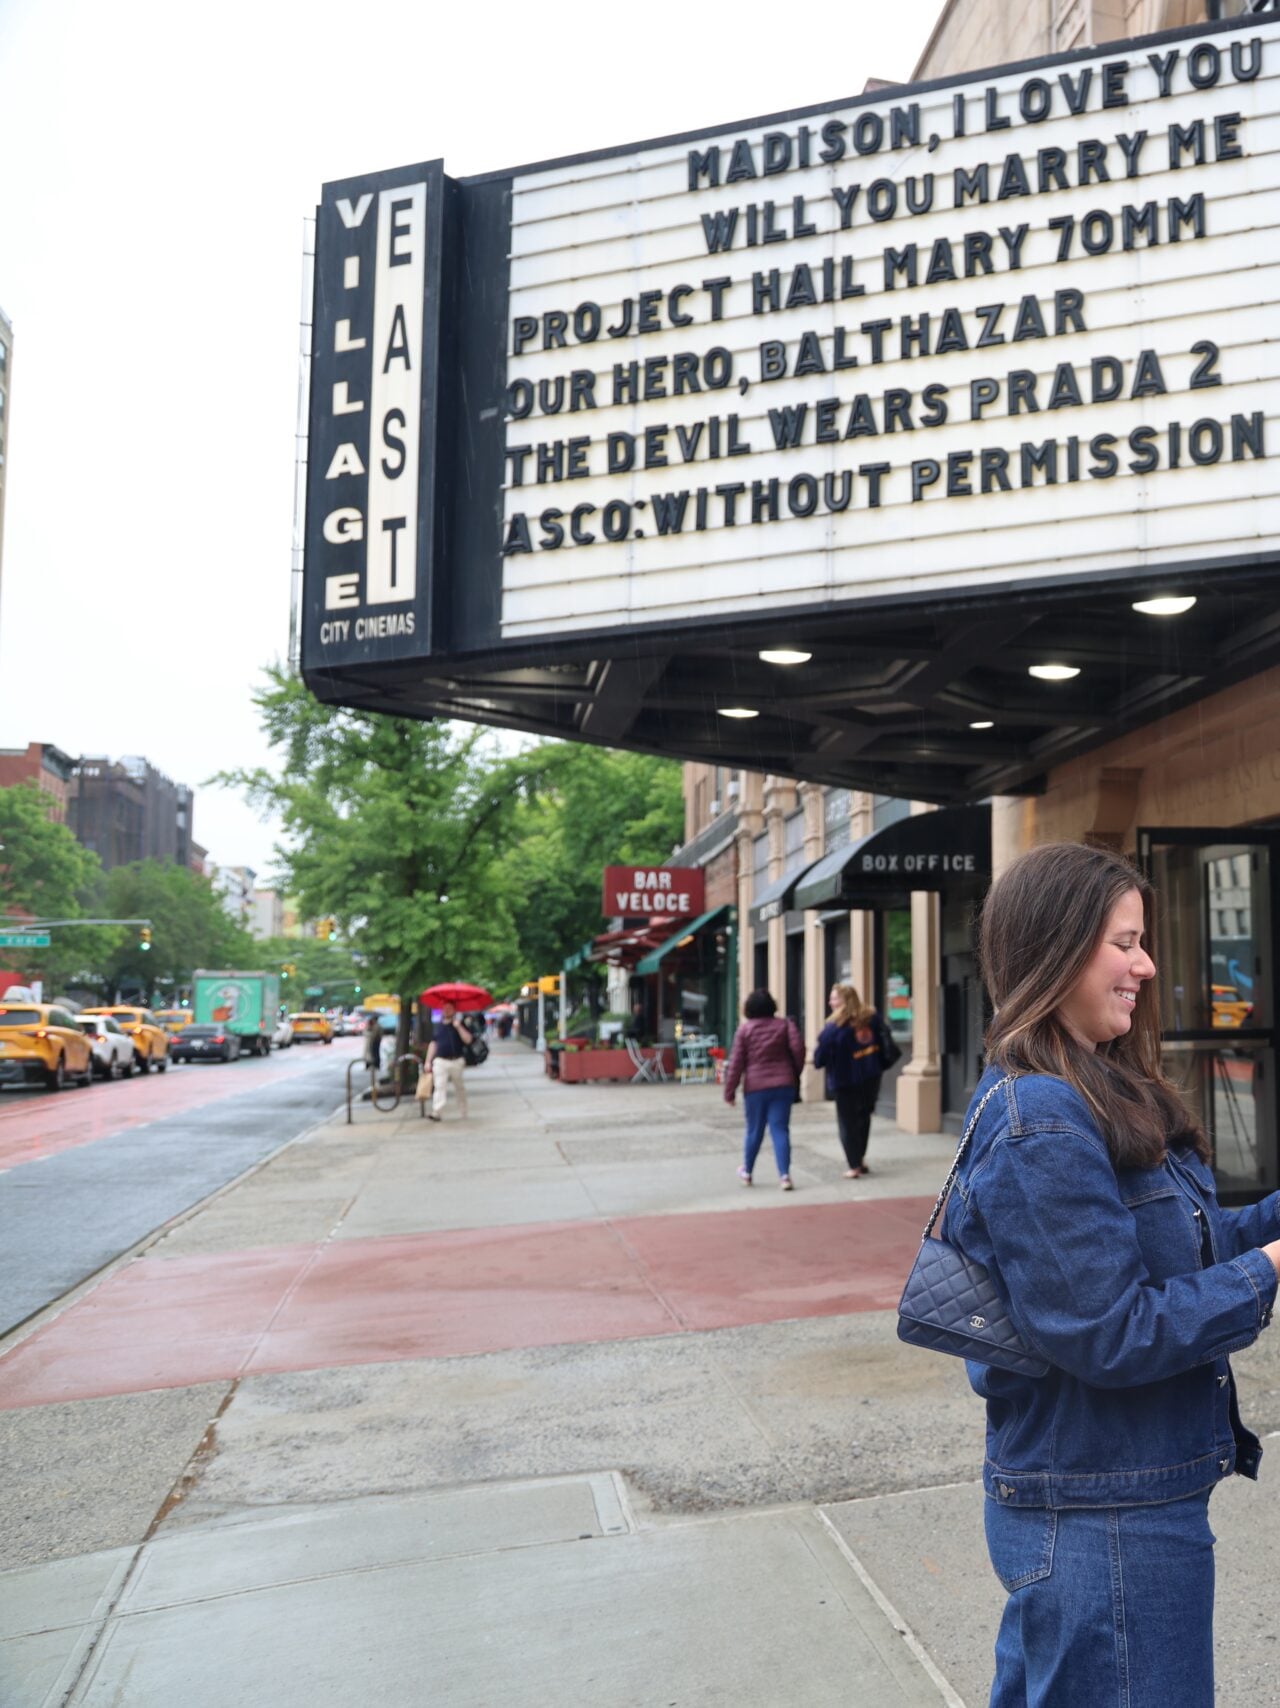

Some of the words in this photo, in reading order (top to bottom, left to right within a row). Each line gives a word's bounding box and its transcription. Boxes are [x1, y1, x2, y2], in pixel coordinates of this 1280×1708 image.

[687, 103, 943, 193] MADISON,
[952, 93, 967, 139] I
[985, 60, 1133, 133] LOVE
[1147, 37, 1265, 99] YOU
[700, 194, 819, 256] WILL
[831, 172, 935, 232] YOU
[952, 130, 1149, 209] MARRY
[1167, 112, 1247, 171] ME
[511, 275, 732, 358] PROJECT
[751, 255, 867, 316] HAIL
[882, 223, 1030, 293] MARY
[1047, 192, 1207, 263] 70MM
[323, 193, 374, 611] VILLAGE
[381, 196, 414, 588] EAST
[503, 435, 592, 489] THE
[606, 412, 752, 476] DEVIL
[767, 383, 950, 452] WEARS
[970, 349, 1168, 422] PRADA
[1188, 339, 1224, 391] 2
[504, 368, 598, 423] OUR
[611, 346, 751, 406] HERO,
[758, 288, 1089, 384] BALTHAZAR
[502, 498, 646, 558] ASCO:
[650, 462, 893, 538] WITHOUT
[909, 411, 1267, 503] PERMISSION
[320, 619, 350, 645] CITY
[355, 611, 416, 641] CINEMAS
[616, 891, 691, 913] VELOCE
[633, 870, 672, 891] BAR
[861, 853, 899, 872] BOX
[903, 853, 976, 872] OFFICE
